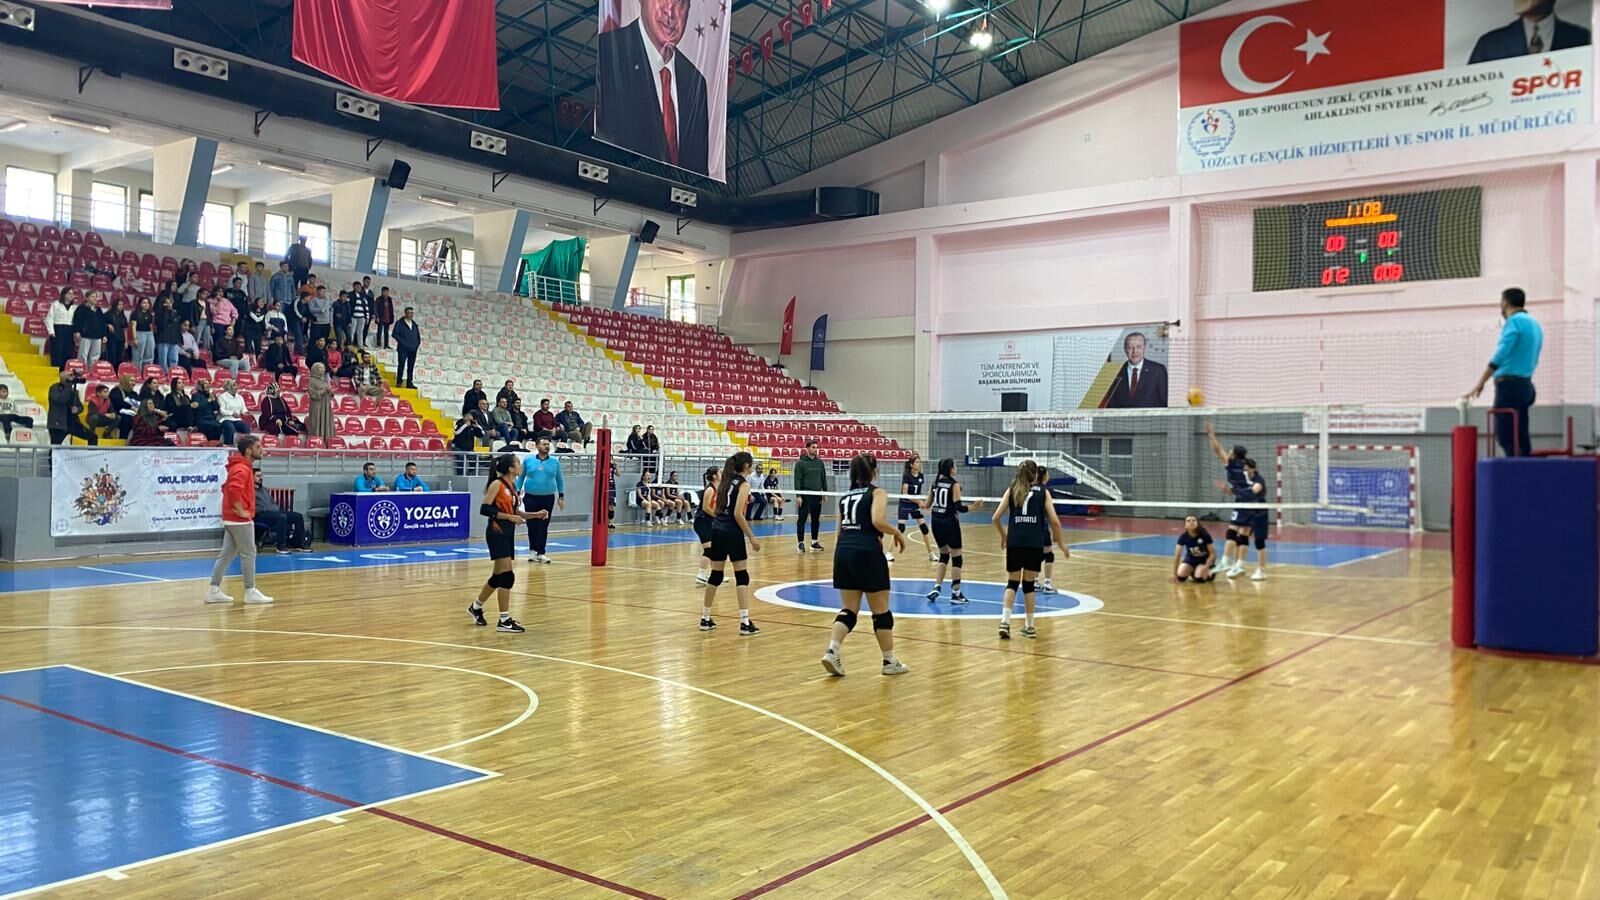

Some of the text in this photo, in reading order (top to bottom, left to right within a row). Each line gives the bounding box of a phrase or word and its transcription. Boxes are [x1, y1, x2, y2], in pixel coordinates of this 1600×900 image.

[1511, 69, 1583, 97] SPOR
[1238, 107, 1258, 117] BEN
[1261, 99, 1324, 115] SPORCUNUN
[1358, 86, 1393, 104] ÇEVİK
[1398, 83, 1412, 94] VE
[1416, 79, 1443, 93] AYNI
[1446, 71, 1505, 88] ZAMANDA
[1303, 104, 1372, 121] AHLAKLISINI
[1200, 154, 1248, 169] YOZGAT
[1250, 145, 1304, 164] GENÇLİK
[1309, 133, 1390, 157] HİZMETLERİ
[1394, 132, 1412, 147] VE
[1416, 126, 1454, 142] SPOR
[1478, 108, 1577, 135] MÜDÜRLÜĞÜ
[1031, 361, 1040, 369] VE
[157, 475, 180, 484] OKUL
[933, 487, 948, 508] 10
[174, 507, 206, 515] YOZGAT
[404, 505, 459, 521] YOZGAT
[841, 493, 864, 525] 17
